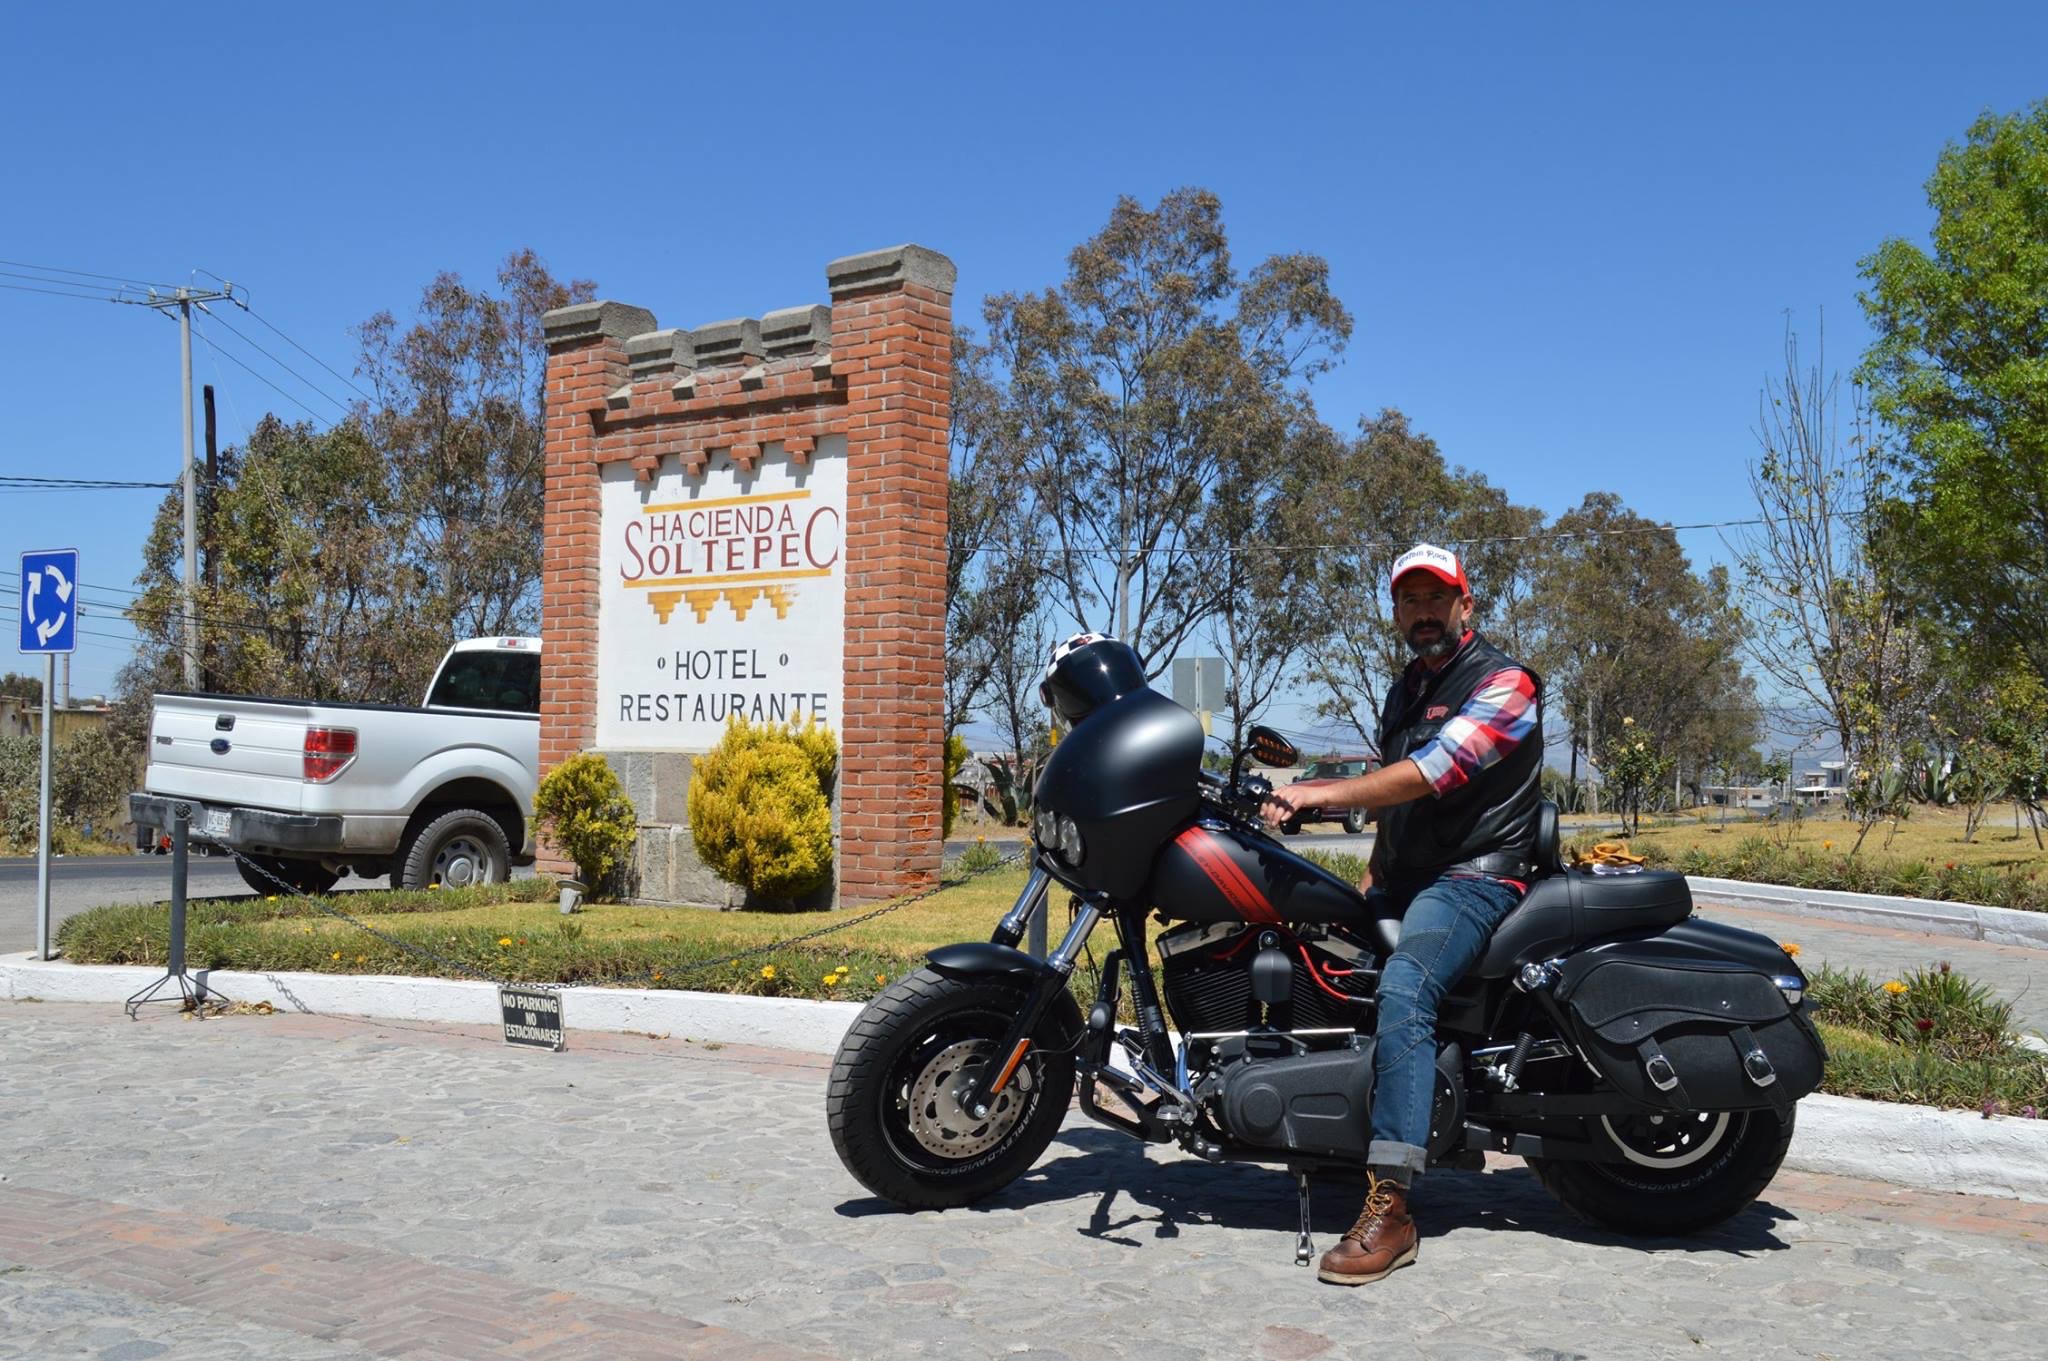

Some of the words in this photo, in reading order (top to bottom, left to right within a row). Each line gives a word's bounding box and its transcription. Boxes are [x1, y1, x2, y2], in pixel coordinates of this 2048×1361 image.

[650, 504, 795, 543] HACIENDA
[620, 506, 839, 581] SOLTEPEC
[675, 649, 766, 680] HOTEL
[619, 693, 828, 722] RESTAURANTE
[1179, 836, 1250, 914] HARLEY-DAVIDSO
[502, 994, 516, 1008] NO
[517, 996, 558, 1013] PARKING
[525, 1012, 537, 1026] NO
[505, 1024, 560, 1044] ESTACIONARSE
[931, 1103, 1036, 1175] HARLEY-DAVIDSON
